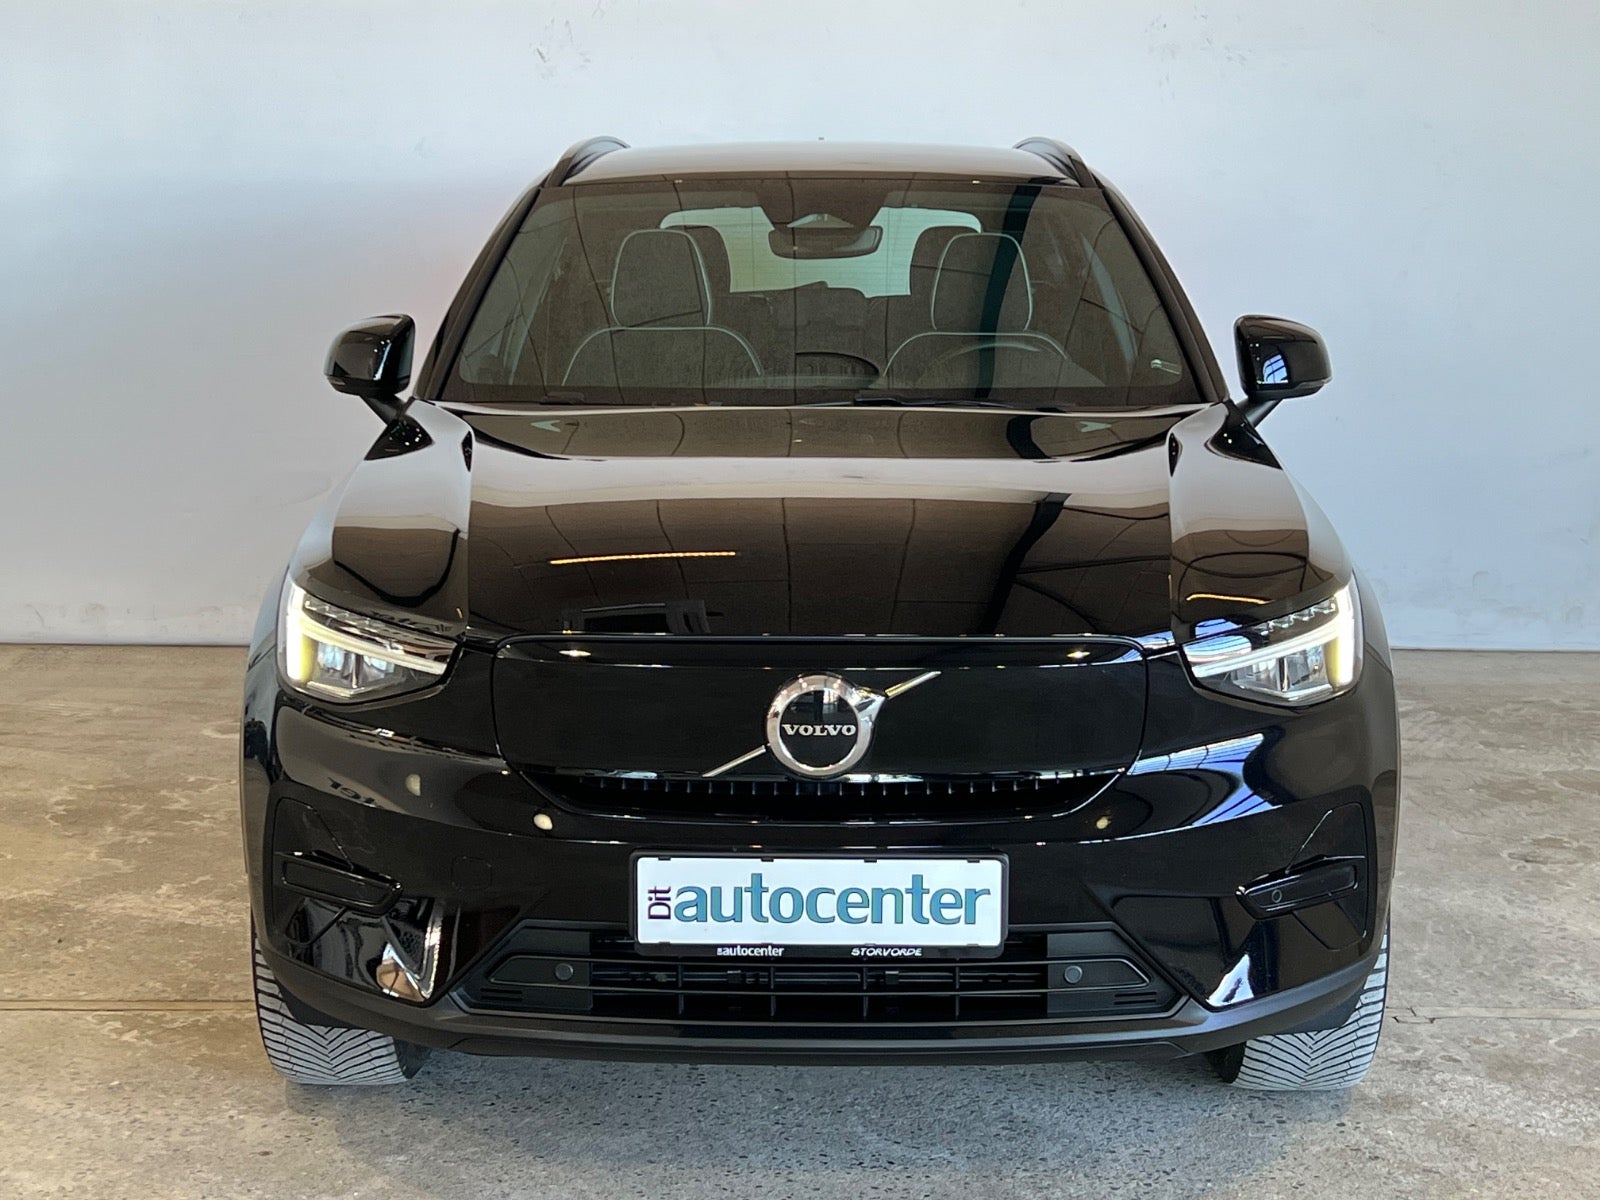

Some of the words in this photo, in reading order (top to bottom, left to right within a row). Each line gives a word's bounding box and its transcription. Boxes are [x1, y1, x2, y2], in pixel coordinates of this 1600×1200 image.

[782, 724, 857, 736] VOLVO
[647, 885, 672, 920] Dit
[673, 872, 991, 925] autocenter
[722, 945, 785, 957] autocenter
[850, 947, 923, 957] STORVORDE
